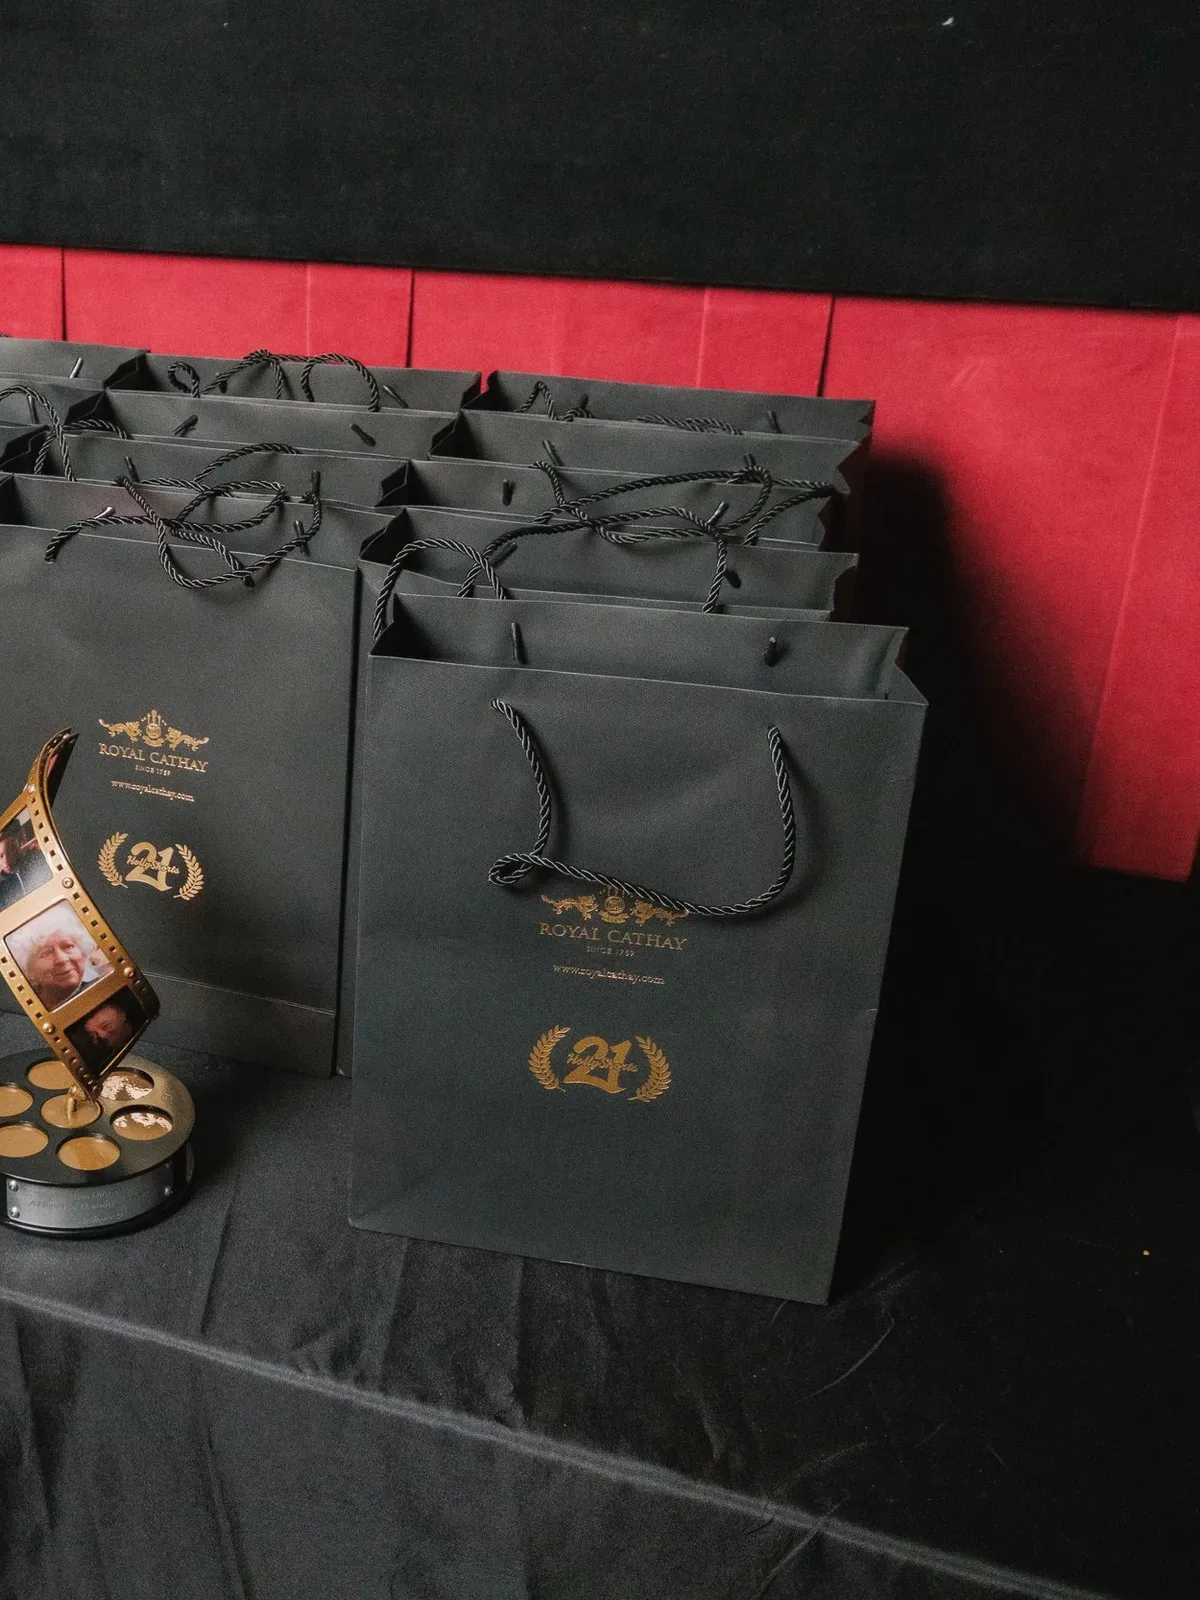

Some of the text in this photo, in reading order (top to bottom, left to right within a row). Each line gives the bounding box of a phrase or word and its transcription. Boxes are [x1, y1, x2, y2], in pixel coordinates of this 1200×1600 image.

[98, 743, 208, 772] ROYAL CATHAY
[135, 764, 155, 774] SINCE
[125, 841, 174, 892] 21
[539, 922, 688, 950] ROYAL CATHAY
[586, 945, 612, 955] SINCE
[553, 964, 665, 984] www.royalcathay.com
[563, 1035, 633, 1094] 21
